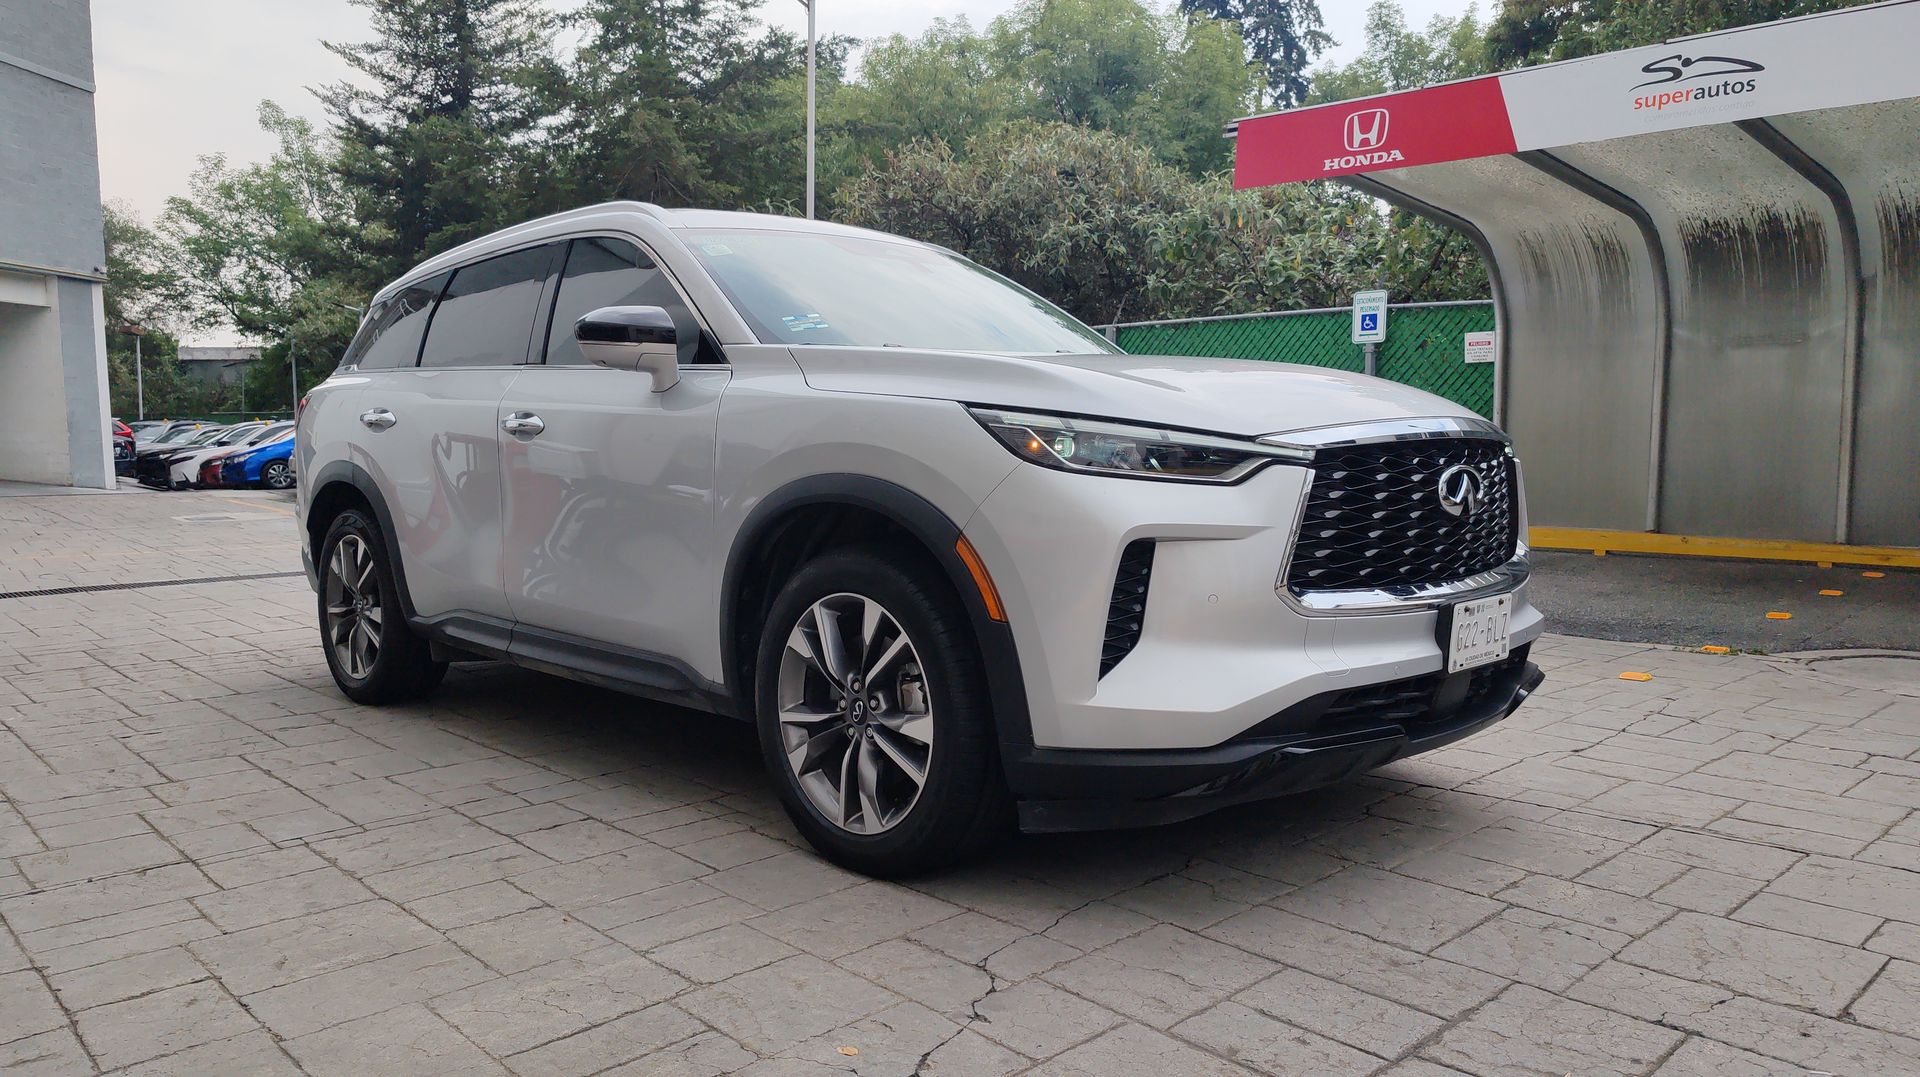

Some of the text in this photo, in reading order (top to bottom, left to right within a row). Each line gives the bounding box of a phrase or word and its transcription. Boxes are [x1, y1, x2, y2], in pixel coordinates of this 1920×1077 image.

[1633, 79, 1757, 111] superautos
[1323, 149, 1405, 171] HONDA
[1456, 612, 1507, 653] G22-BLZ
